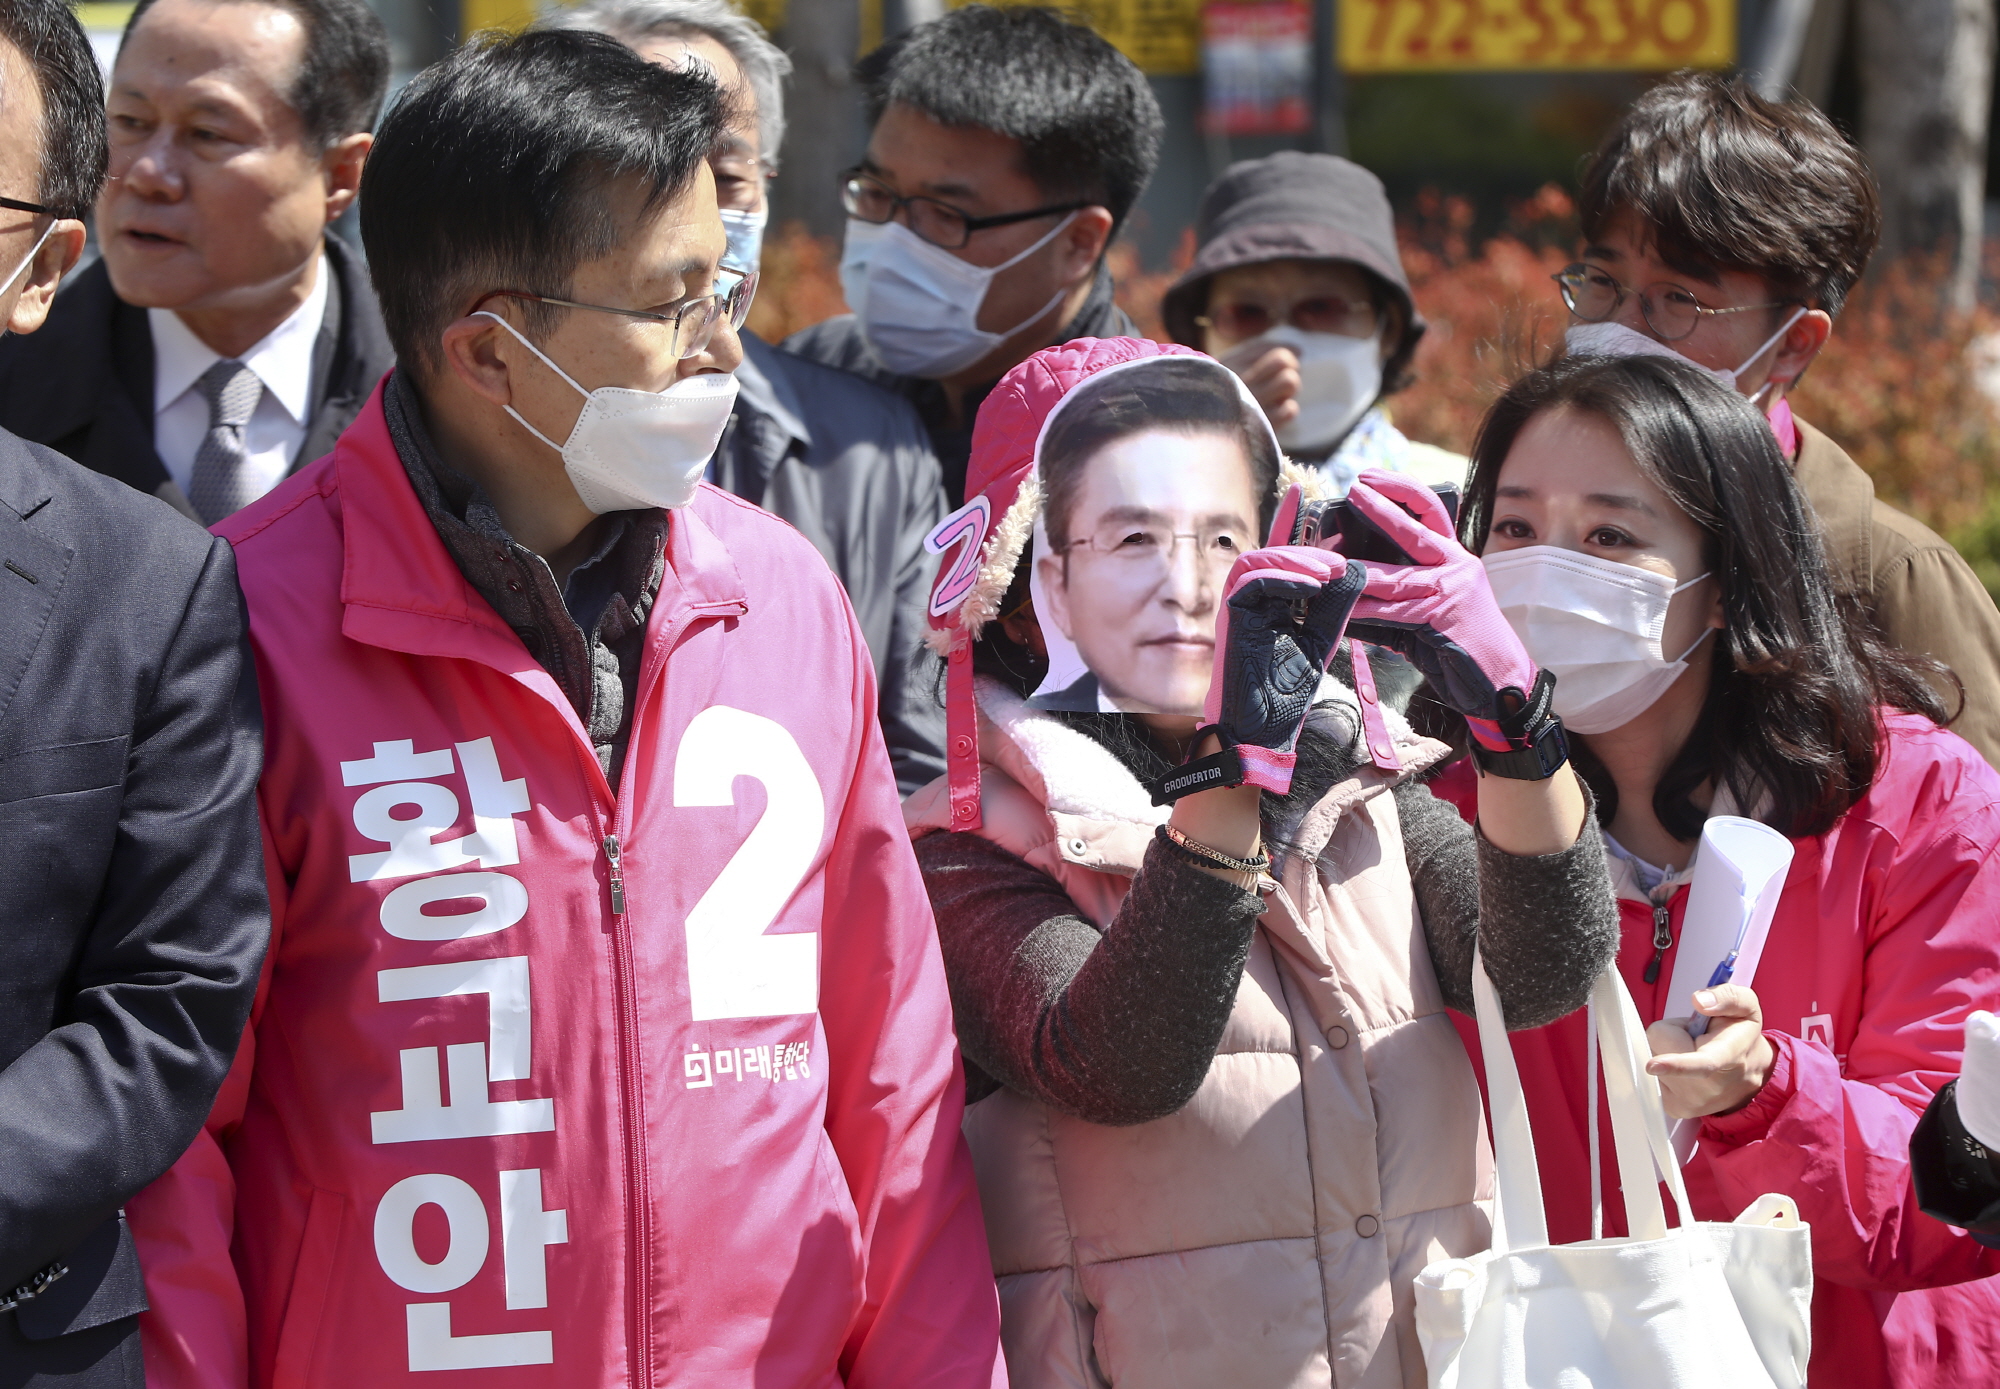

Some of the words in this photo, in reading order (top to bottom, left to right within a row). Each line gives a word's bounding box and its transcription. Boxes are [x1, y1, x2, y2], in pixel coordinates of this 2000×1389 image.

[926, 502, 988, 612] 2
[672, 704, 825, 1022] 2
[340, 737, 568, 1372] 황교안
[714, 1040, 811, 1083] 미래통합당
